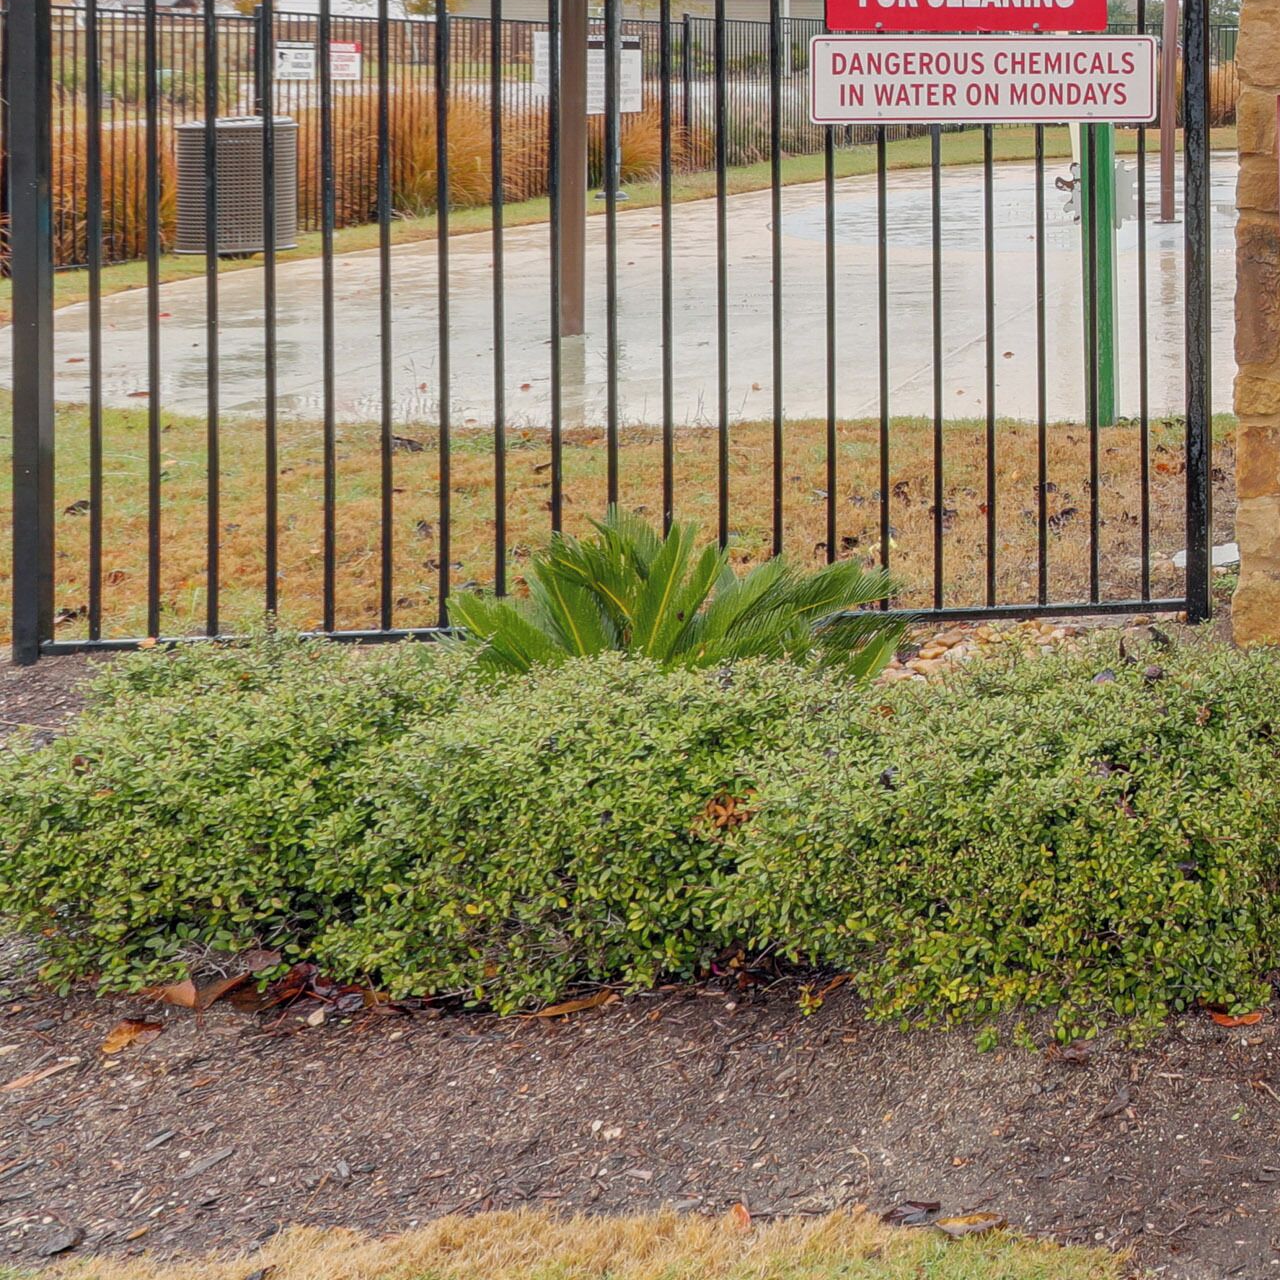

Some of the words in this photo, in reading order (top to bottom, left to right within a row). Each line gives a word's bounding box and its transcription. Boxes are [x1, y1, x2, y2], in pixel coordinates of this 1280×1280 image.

[831, 51, 986, 76] DANGEROUS
[993, 51, 1135, 75] CHEMICALS
[839, 83, 865, 107] IN
[874, 83, 957, 106] WATER
[965, 83, 1000, 106] ON
[1009, 82, 1127, 106] MONDAYS
